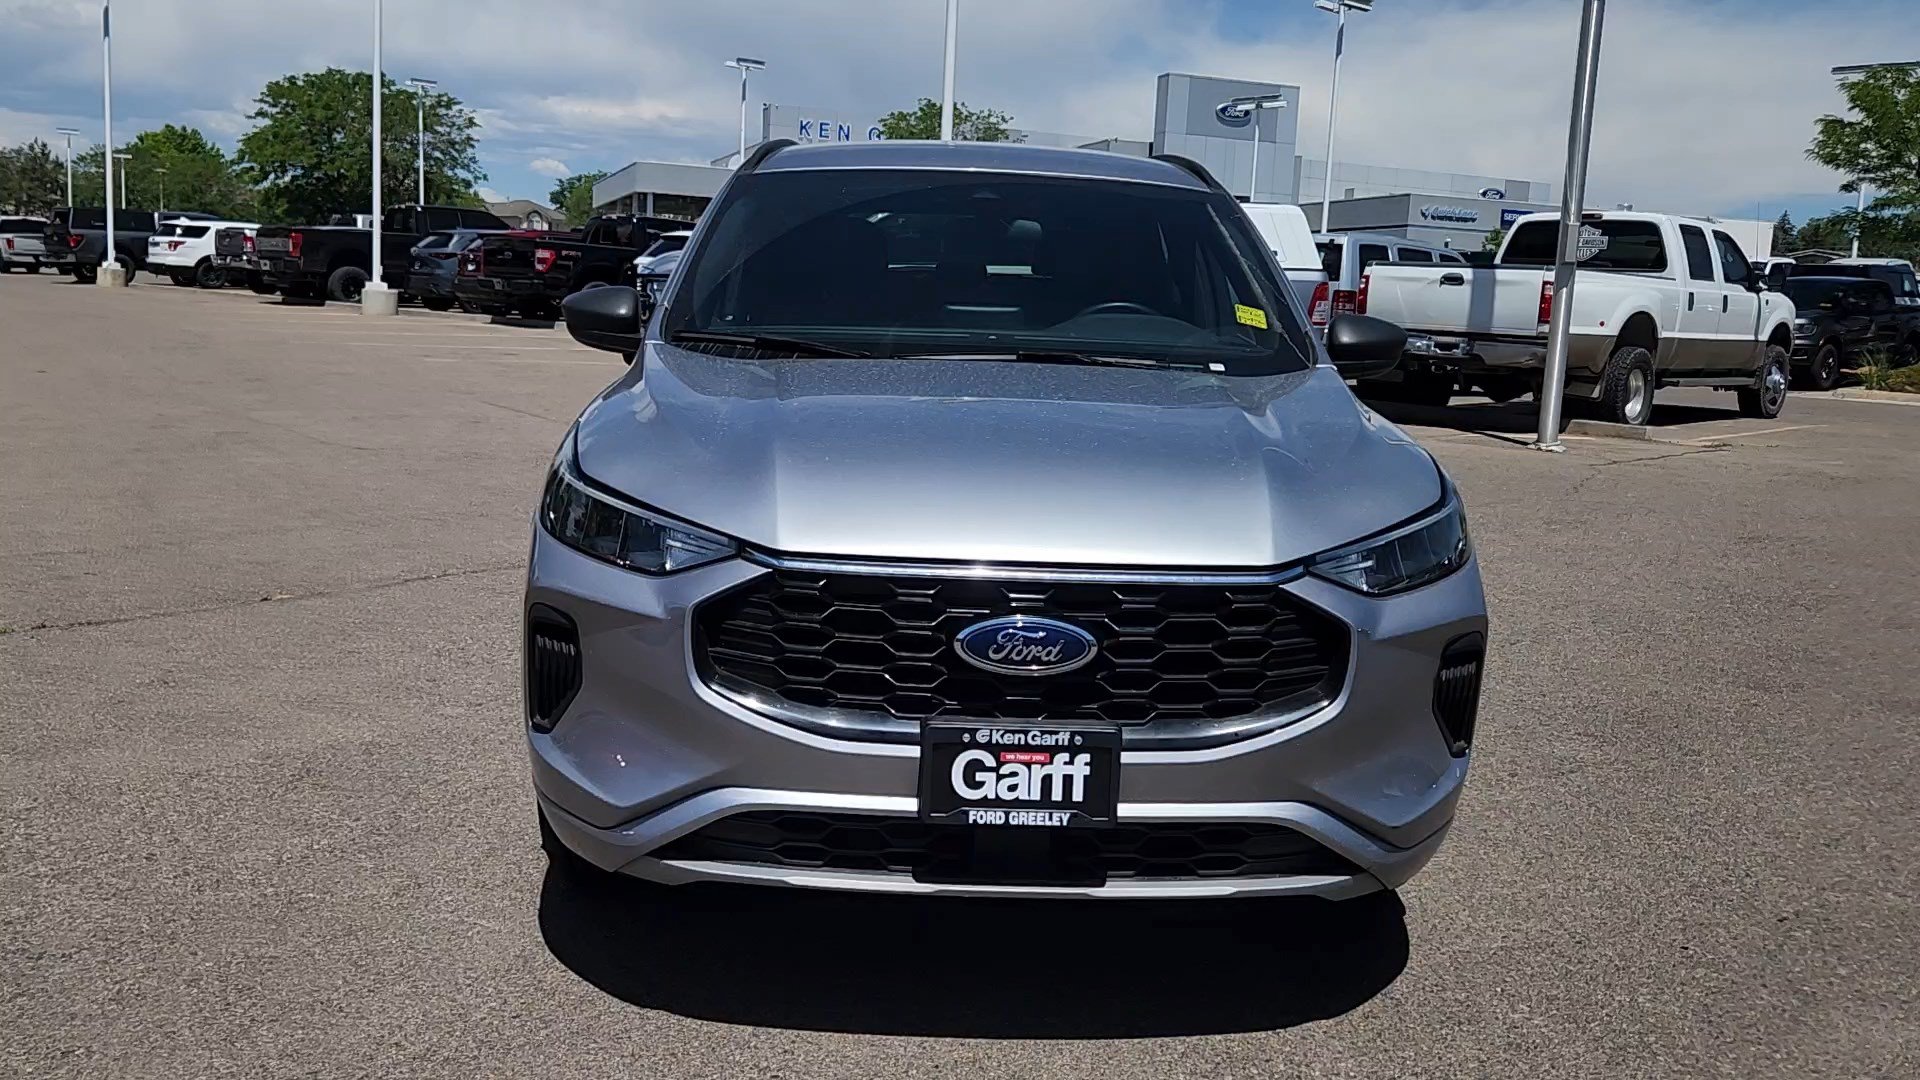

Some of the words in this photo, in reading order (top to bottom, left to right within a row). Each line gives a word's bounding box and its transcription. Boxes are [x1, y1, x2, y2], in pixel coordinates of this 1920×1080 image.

[799, 119, 851, 142] KEN
[988, 628, 1065, 662] Ford
[992, 730, 1025, 745] Ken
[1027, 731, 1071, 746] Garff
[951, 749, 1091, 802] Garff
[968, 810, 1006, 825] FORD
[1008, 811, 1072, 826] GREELEY
